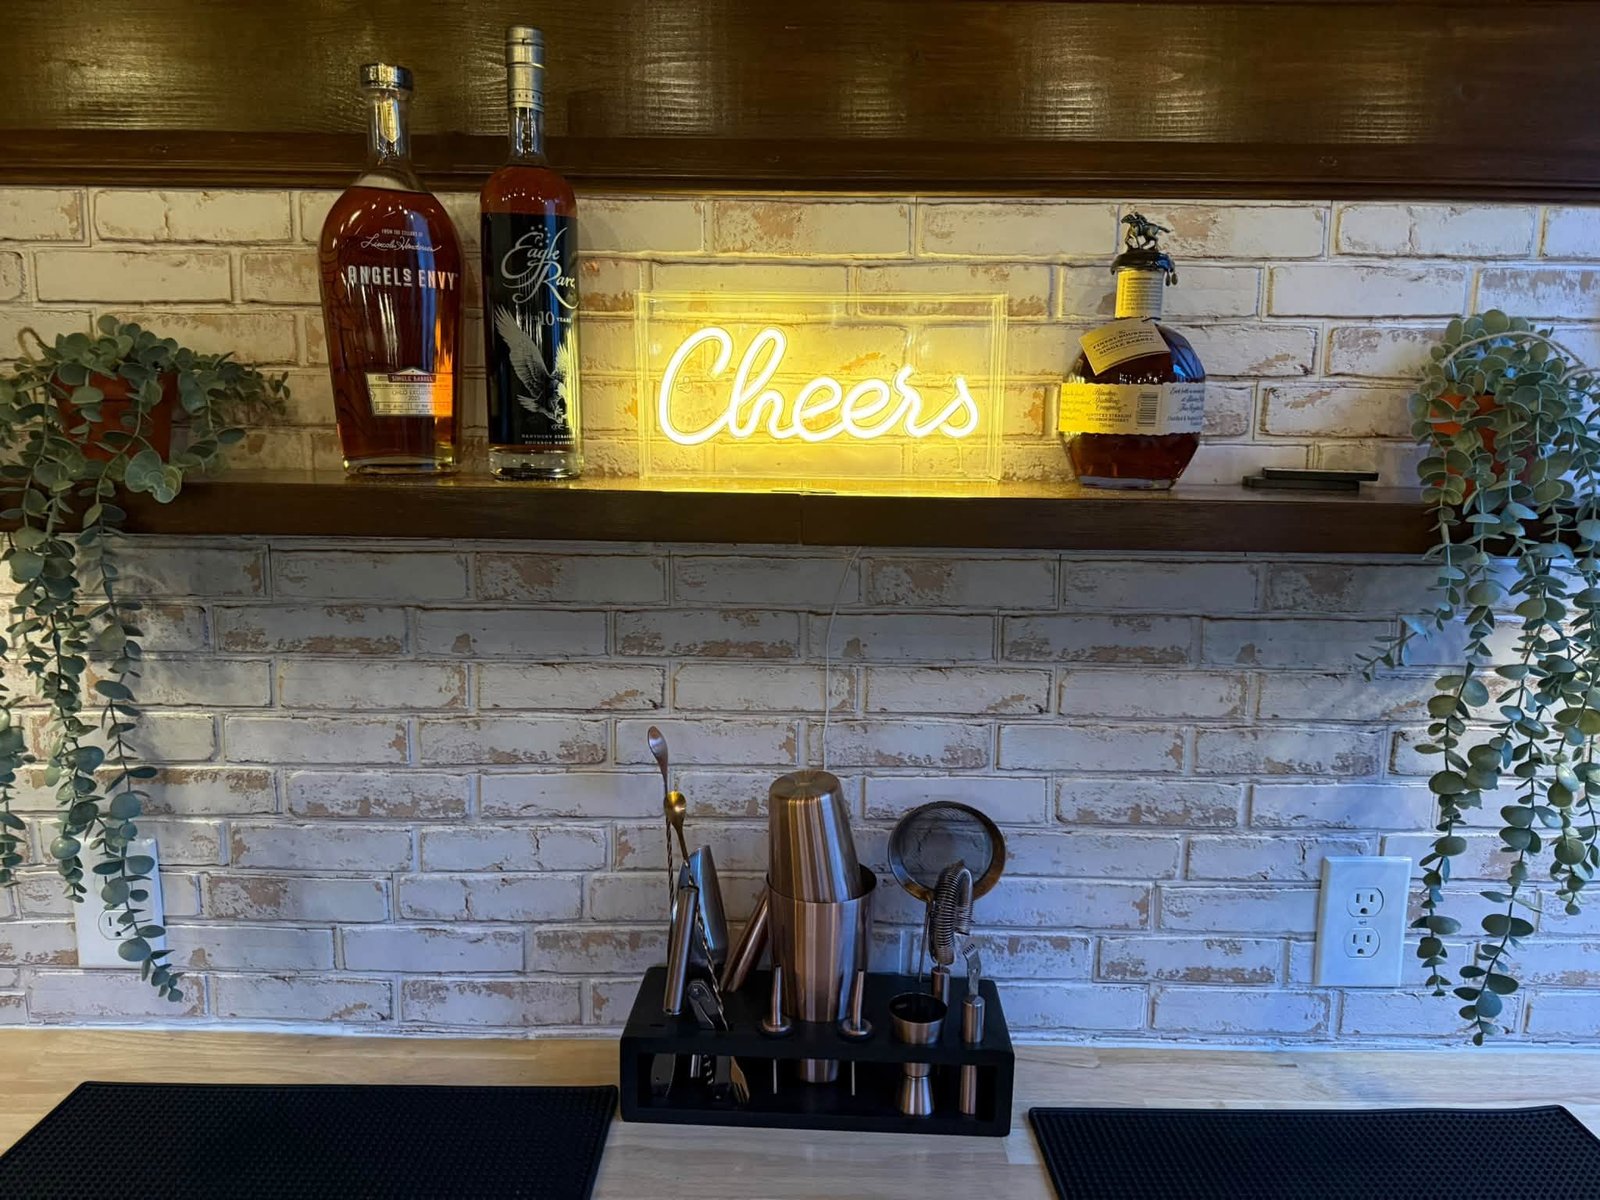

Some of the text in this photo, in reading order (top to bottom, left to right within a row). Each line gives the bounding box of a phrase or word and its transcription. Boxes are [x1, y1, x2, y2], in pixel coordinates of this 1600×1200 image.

[347, 265, 455, 290] ANGELS ENVY
[501, 226, 567, 288] Eagle
[512, 260, 579, 310] Rare
[659, 325, 980, 446] Cheers
